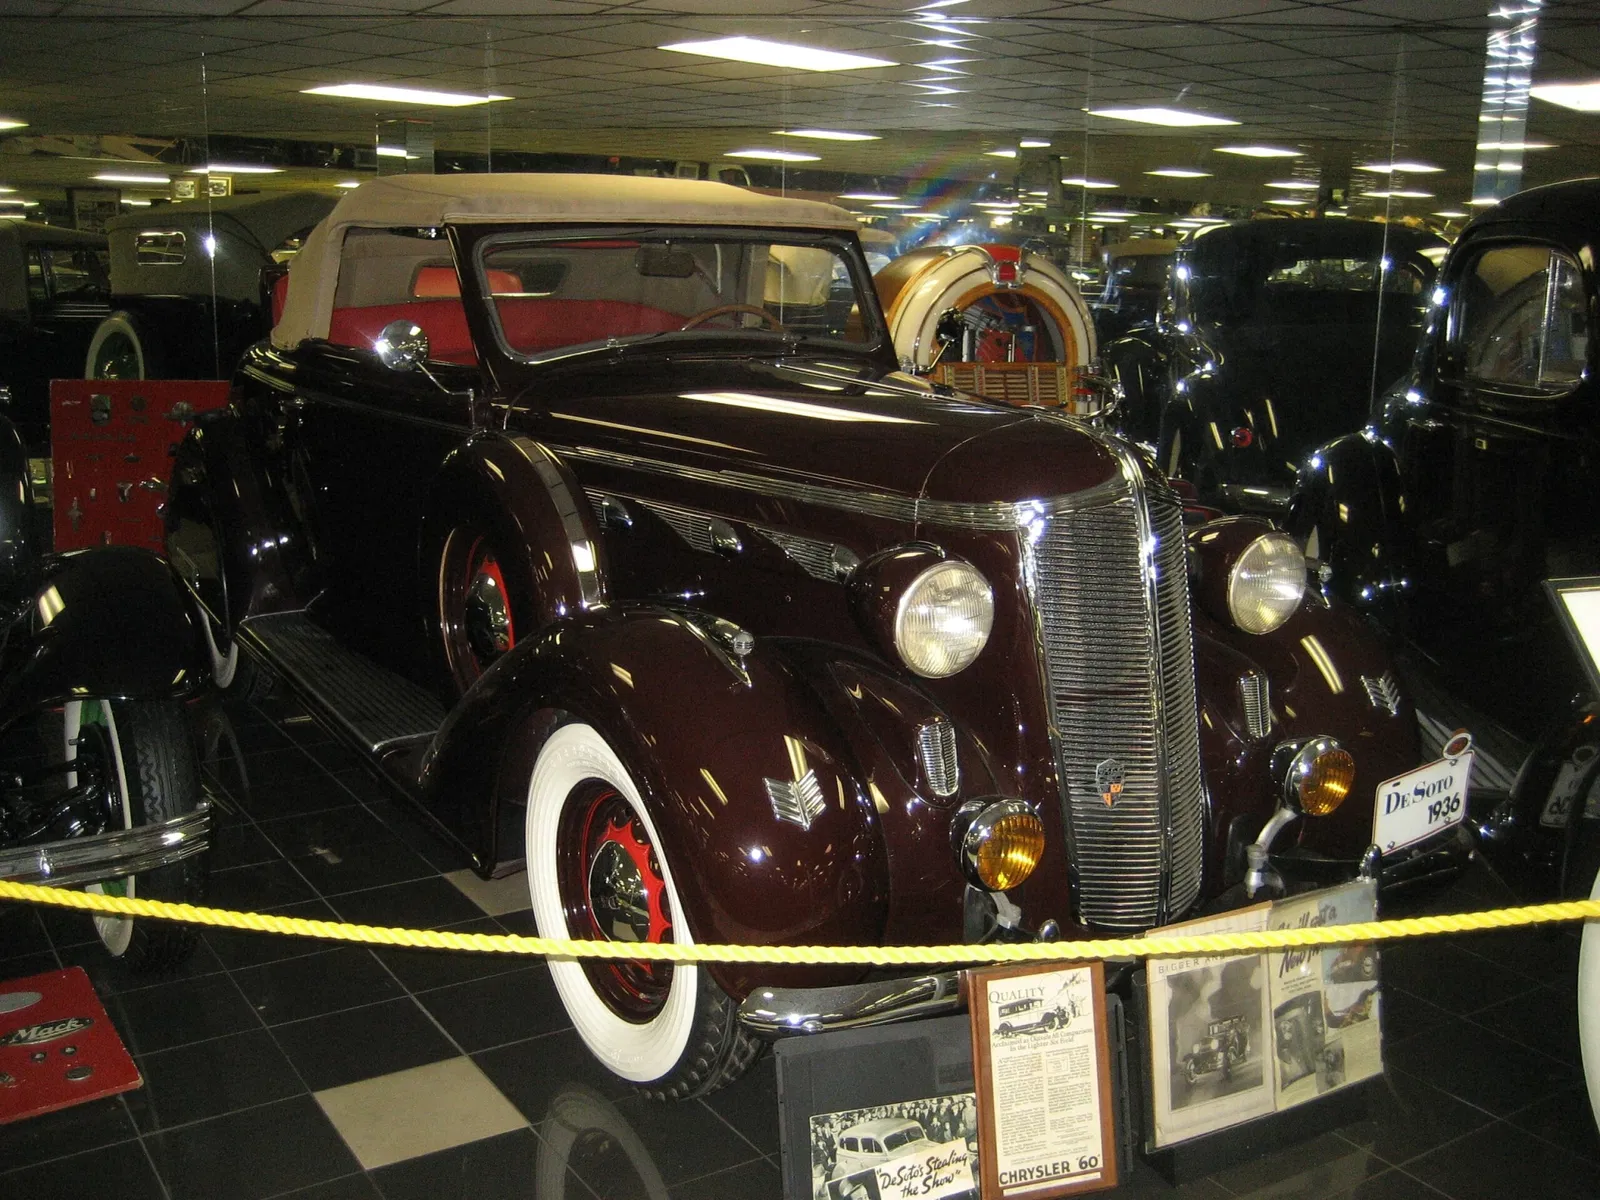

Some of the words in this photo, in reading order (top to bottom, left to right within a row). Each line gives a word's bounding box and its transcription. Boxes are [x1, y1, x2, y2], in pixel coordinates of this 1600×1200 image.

[1428, 792, 1460, 824] 1936
[1158, 959, 1200, 974] BIGGER
[1205, 953, 1225, 964] AND
[989, 987, 1046, 1004] QUALITY
[9, 1017, 84, 1043] Mack
[926, 1150, 968, 1175] Stealing
[1000, 1161, 1070, 1185] CHRYSLER
[900, 1182, 919, 1198] the
